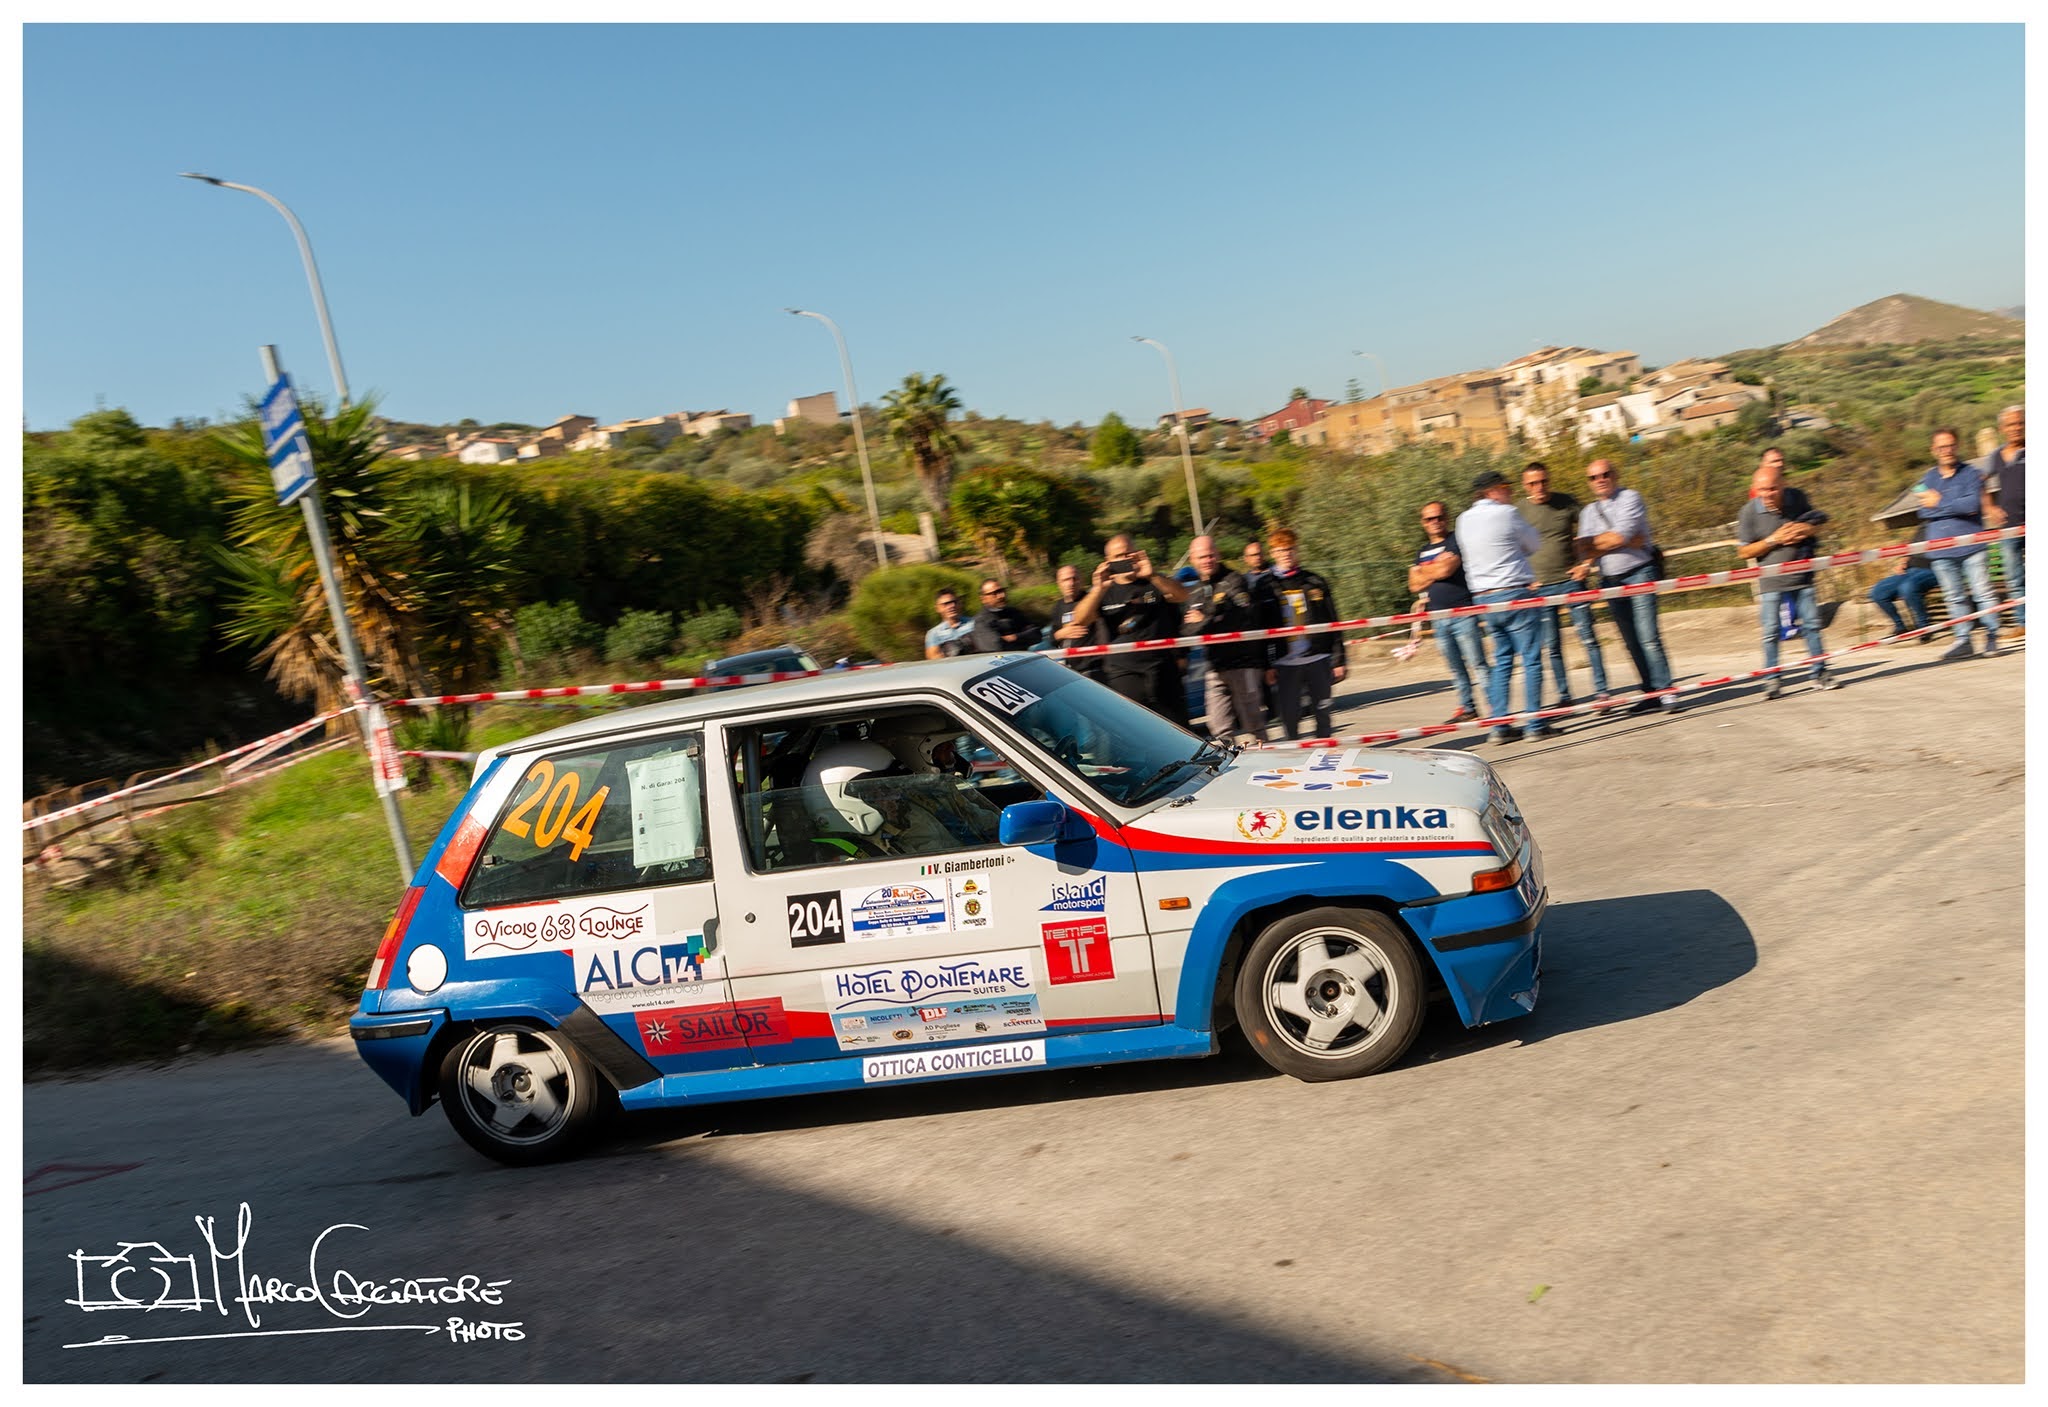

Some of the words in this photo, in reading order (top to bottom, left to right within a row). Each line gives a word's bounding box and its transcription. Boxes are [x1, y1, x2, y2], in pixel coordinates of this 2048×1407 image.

[976, 677, 1035, 711] 204
[649, 781, 656, 789] di
[656, 779, 673, 788] Gara:
[502, 760, 610, 862] 204
[1294, 805, 1448, 831] elenka
[1293, 835, 1331, 843] Ingredienti
[1379, 835, 1409, 843] gelateria
[1416, 834, 1455, 842] pasticceria
[933, 863, 942, 875] V.
[944, 855, 1005, 874] Giambertoni
[892, 888, 914, 900] Rally
[1051, 878, 1105, 901] island
[1053, 896, 1105, 911] motorsport
[788, 898, 842, 938] 204
[541, 913, 576, 942] 63
[1043, 923, 1107, 940] TEMPO
[583, 987, 642, 1004] integration
[642, 983, 705, 999] technology
[973, 985, 1007, 995] SUITES
[632, 999, 675, 1008] www.alc14.com
[870, 1013, 903, 1022] NICOLETTI
[922, 1007, 949, 1020] DLF
[678, 1012, 771, 1040] SAILOR
[934, 1022, 961, 1031] Pugliese
[868, 1056, 927, 1079] OTTICA
[931, 1045, 1034, 1070] CONTICELLO
